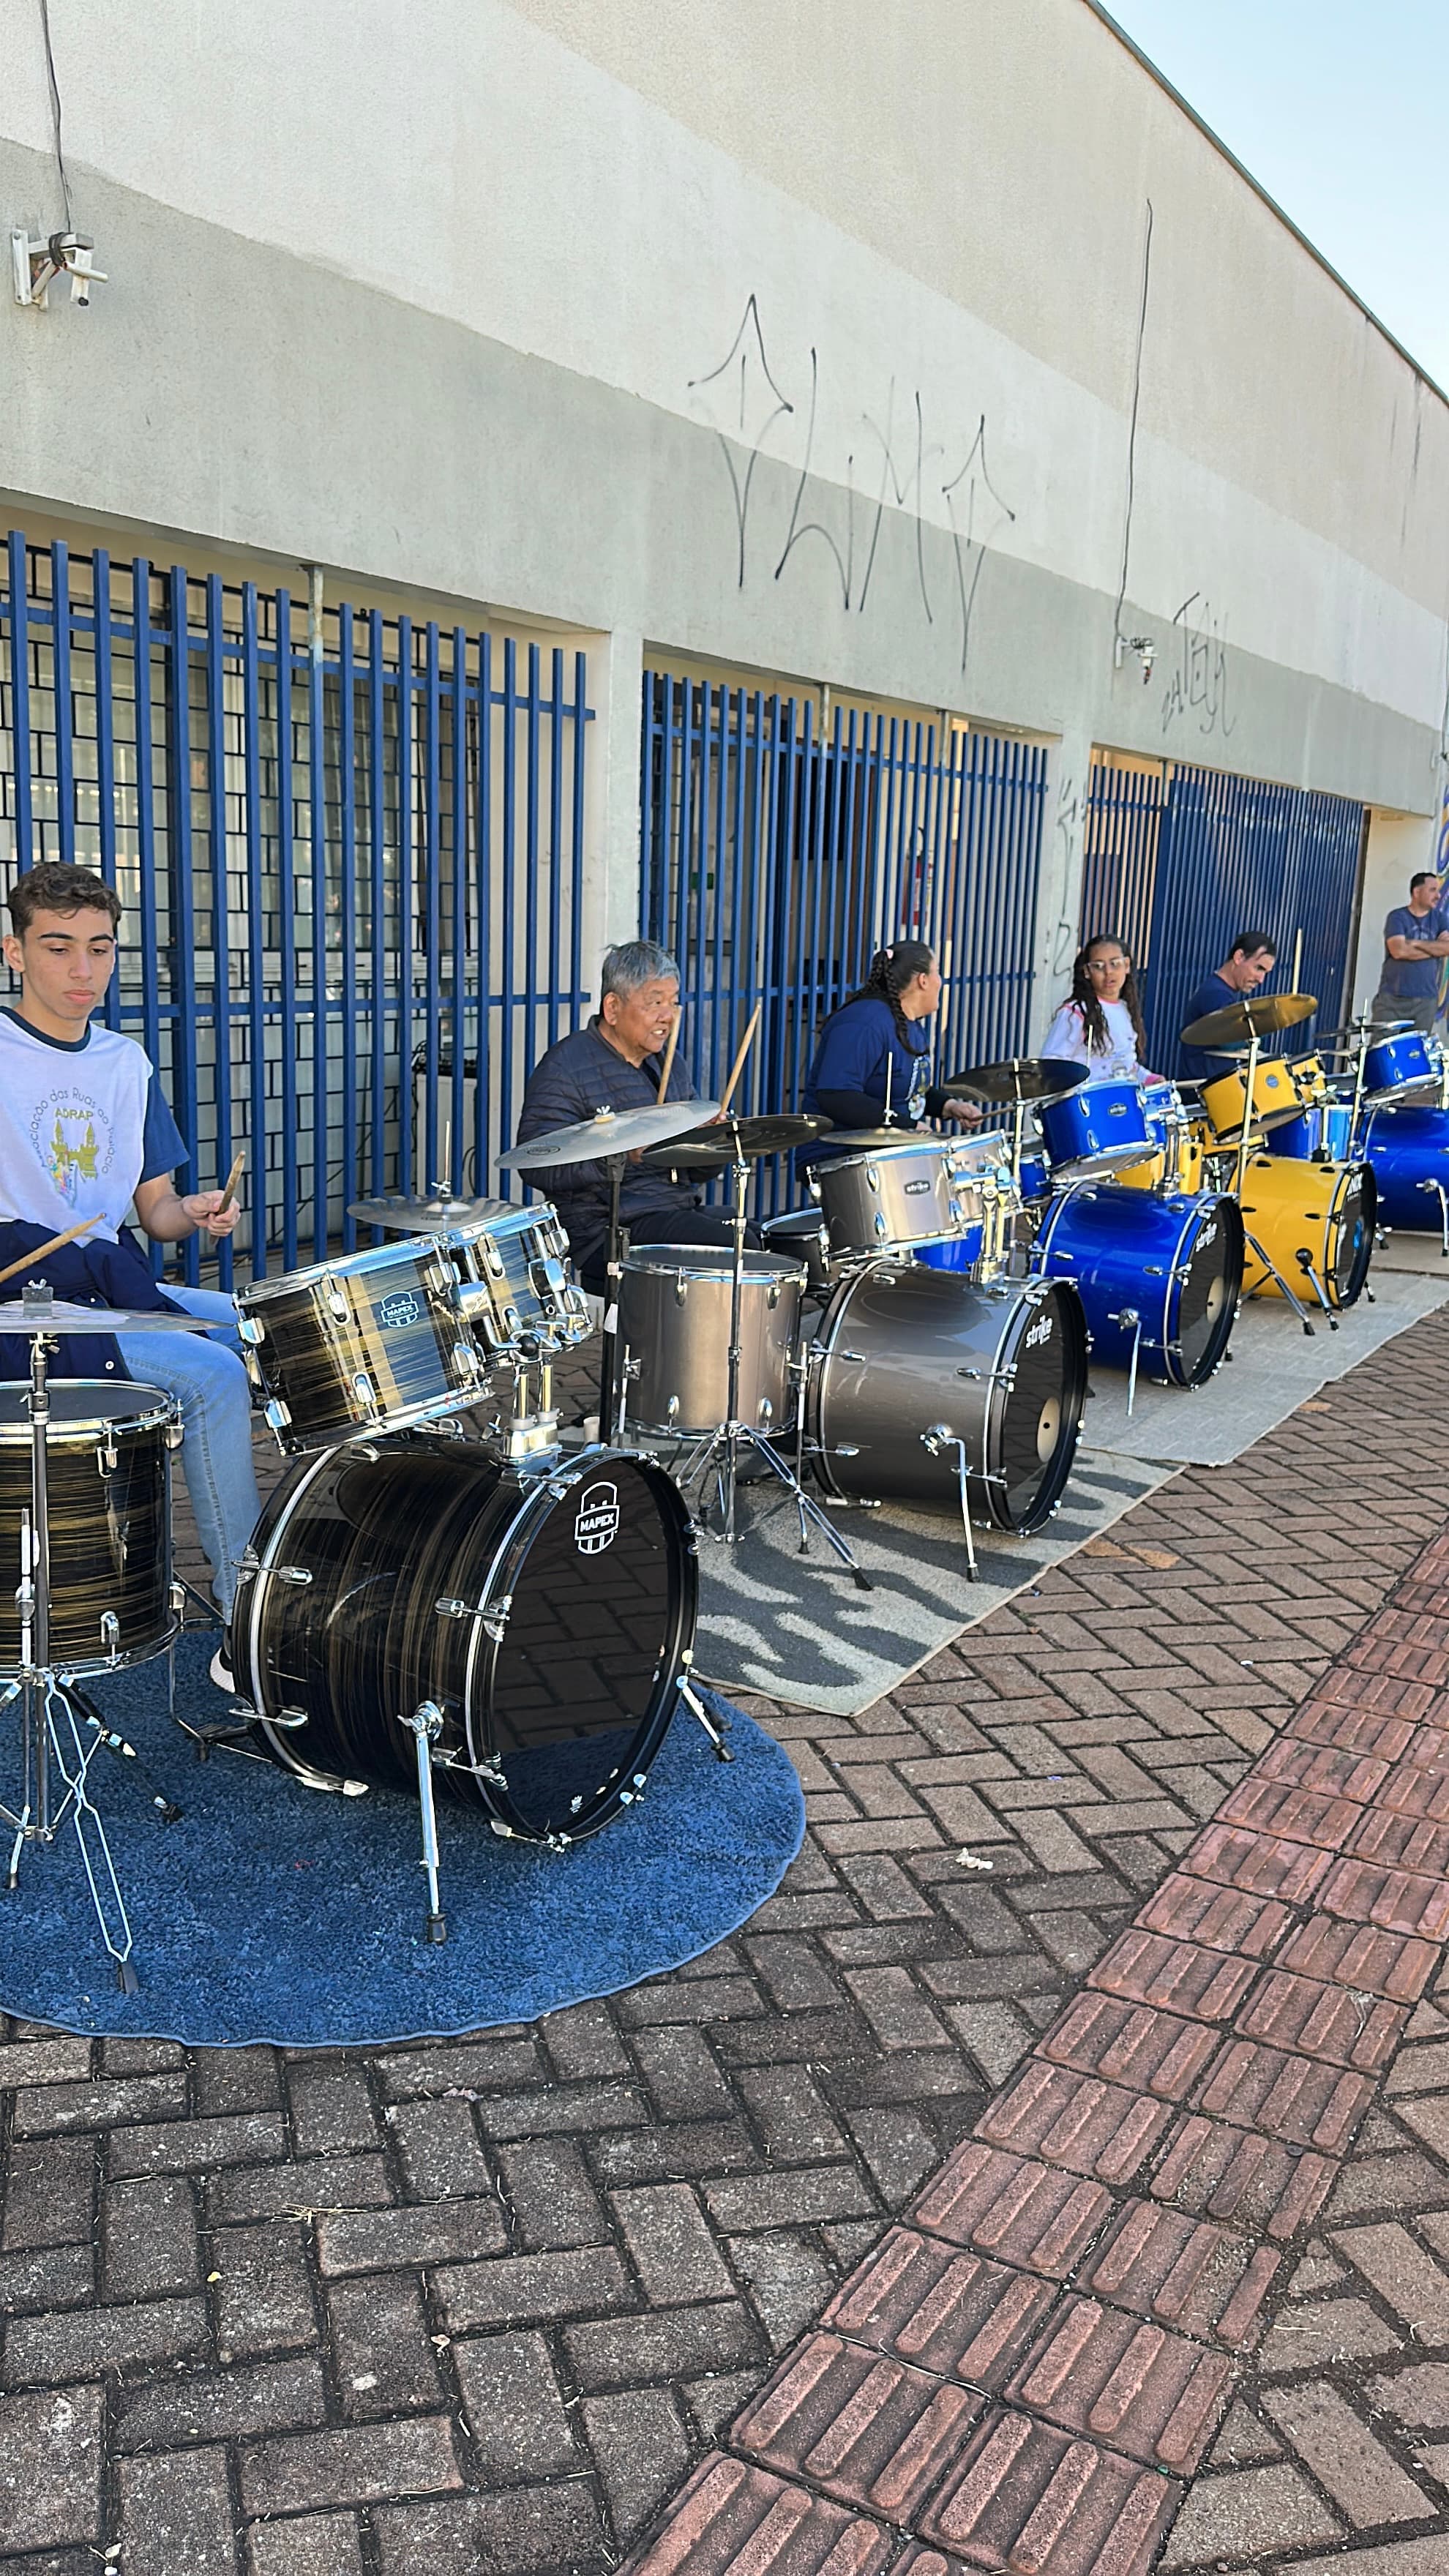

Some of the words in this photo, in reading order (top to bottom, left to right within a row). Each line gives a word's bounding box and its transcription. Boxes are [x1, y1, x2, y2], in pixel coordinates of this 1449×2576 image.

[72, 1087, 97, 1108] Ruas
[97, 1109, 109, 1124] ao
[386, 1304, 414, 1317] MAPEX
[1025, 1315, 1052, 1348] strike
[580, 1513, 615, 1532] MAPEX
